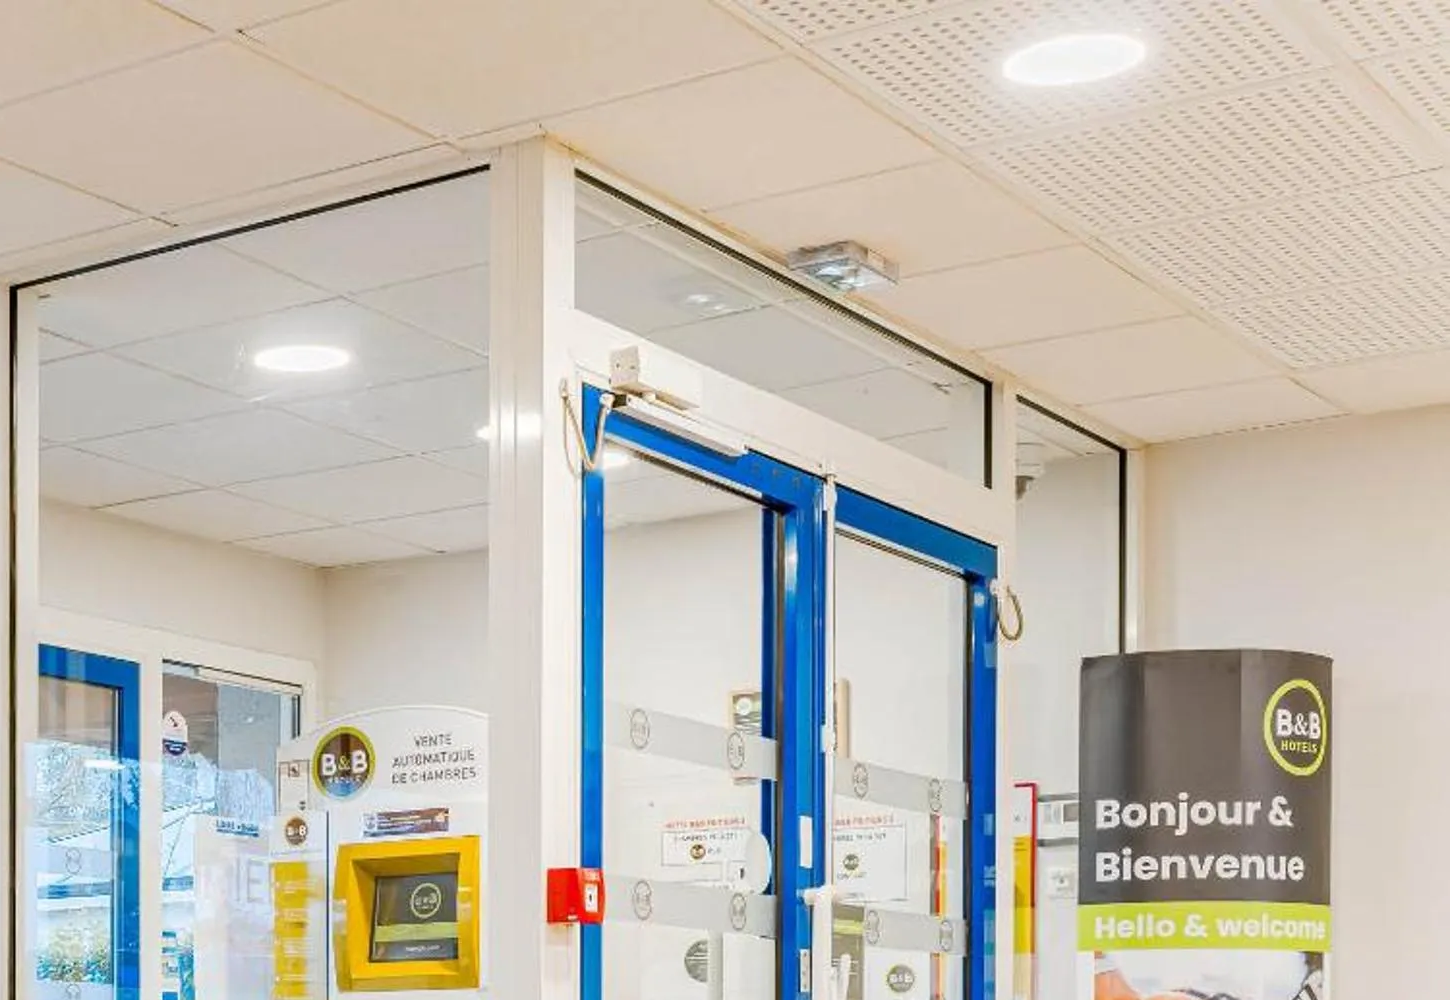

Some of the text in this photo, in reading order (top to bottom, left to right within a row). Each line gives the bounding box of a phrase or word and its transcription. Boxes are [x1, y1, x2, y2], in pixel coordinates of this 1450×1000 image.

[1276, 708, 1321, 740] B&B
[413, 733, 452, 747] VENTE
[1281, 740, 1318, 753] HOTELS
[321, 749, 368, 776] B&B
[392, 749, 475, 769] AUTOMATIQUE
[392, 767, 476, 784] DE CHAMBRES
[1095, 792, 1294, 836] Bonjour &
[1095, 848, 1305, 883] Bienvenue
[1094, 914, 1176, 940] Hello
[1184, 914, 1209, 939] &
